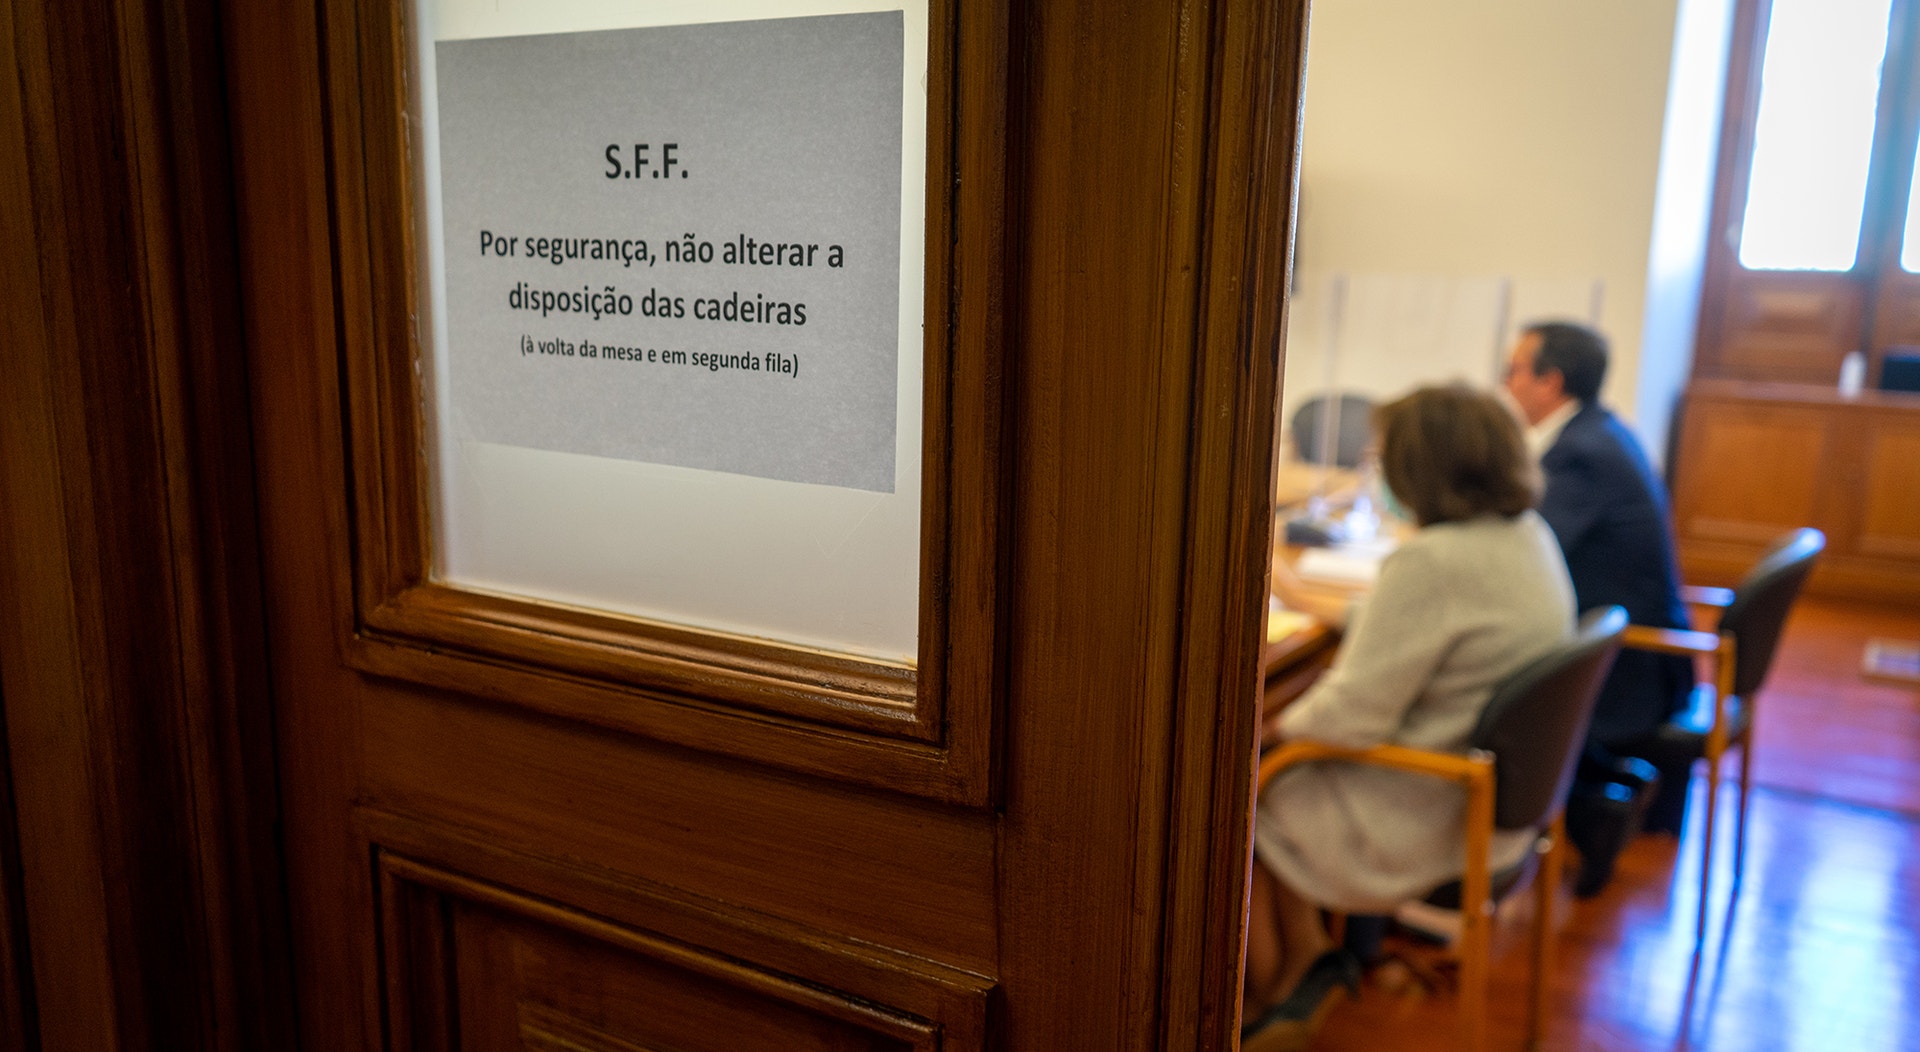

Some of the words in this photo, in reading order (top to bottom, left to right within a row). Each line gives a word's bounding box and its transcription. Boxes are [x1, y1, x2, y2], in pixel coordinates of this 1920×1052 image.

[604, 142, 689, 180] S.F.F.
[480, 229, 519, 258] Por
[524, 236, 657, 269] segurança,
[665, 232, 715, 264] não
[722, 233, 819, 267] alterar
[827, 244, 844, 269] a
[508, 281, 634, 321] disposição
[641, 287, 686, 319] das
[693, 290, 807, 327] cadeiras
[520, 334, 535, 357] (à
[537, 337, 575, 357] volta
[578, 339, 598, 359] da
[601, 345, 643, 362] mesa
[647, 348, 657, 363] e
[661, 349, 687, 366] em
[691, 350, 761, 372] segunda
[764, 351, 799, 379] fila)
